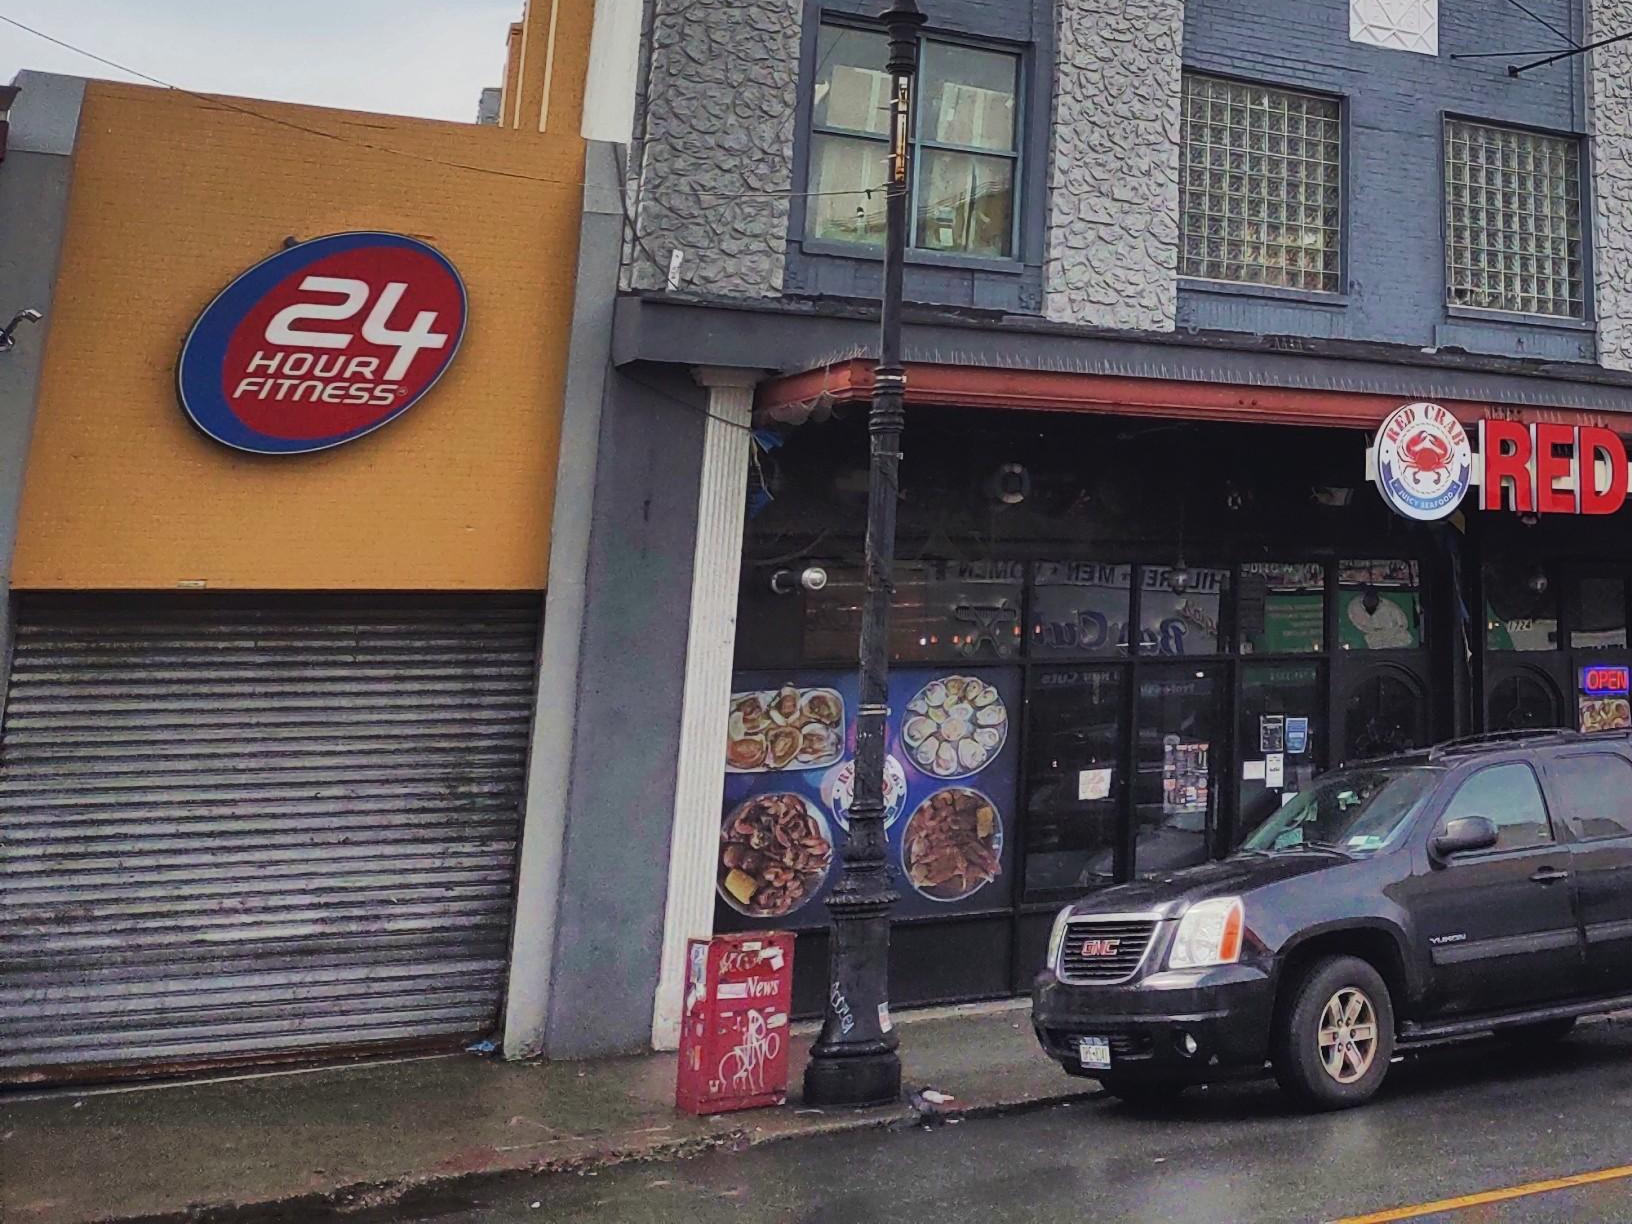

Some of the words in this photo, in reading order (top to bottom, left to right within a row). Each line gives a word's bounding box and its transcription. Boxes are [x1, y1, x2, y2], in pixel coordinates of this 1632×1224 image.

[264, 276, 449, 381] 24
[246, 351, 380, 380] HOUR
[232, 377, 399, 406] FITNESS
[1386, 408, 1416, 445] RED
[1424, 405, 1465, 446] CRAB
[1480, 419, 1629, 515] RED
[1398, 490, 1420, 506] JUICY
[1421, 491, 1454, 509] SEAFOOD
[1586, 669, 1628, 691] OPEN
[1081, 939, 1121, 956] GMC
[748, 977, 780, 998] News
